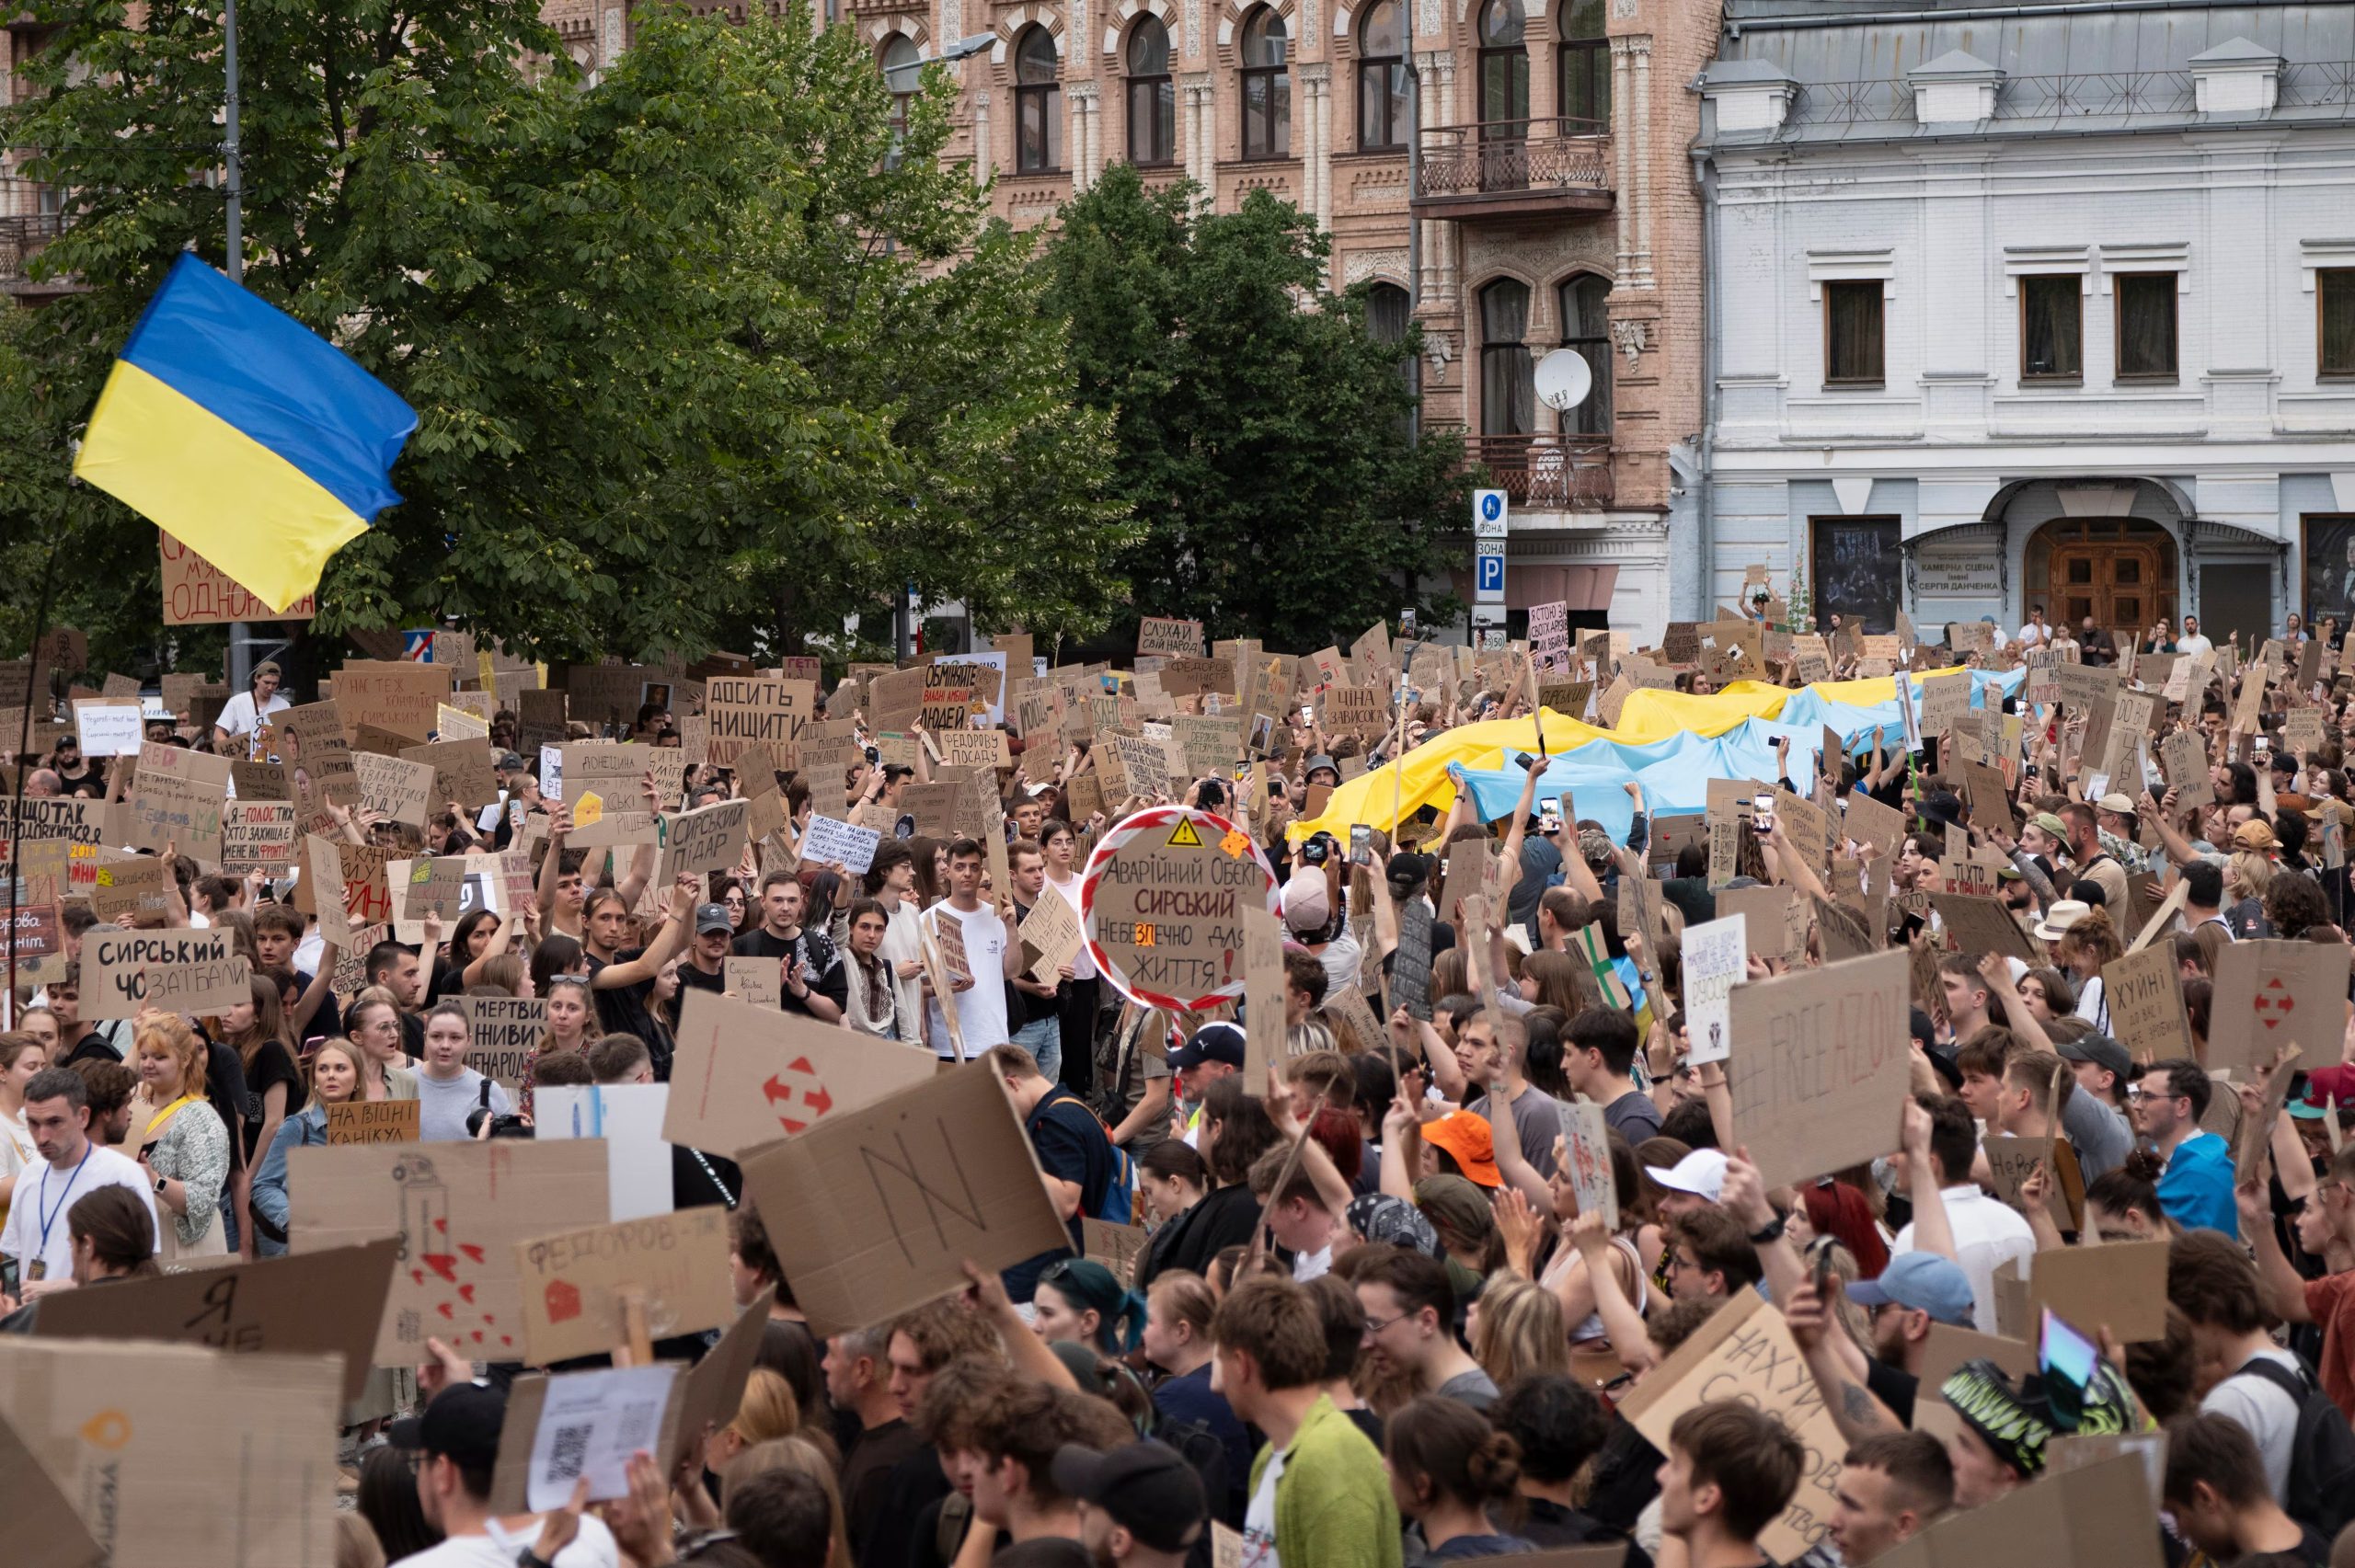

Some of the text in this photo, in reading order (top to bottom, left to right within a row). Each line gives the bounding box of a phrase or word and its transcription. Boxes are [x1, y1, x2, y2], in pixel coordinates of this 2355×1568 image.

[1480, 524, 1502, 533] ЗОНА
[1477, 544, 1504, 555] ЗОНА
[1922, 563, 1995, 572] КАМЕРНА СЦЕНА
[1919, 582, 1998, 591] СЕРГІЯ ДАНЧЕНКА
[1143, 620, 1192, 642] СЛУХАЙ
[1142, 639, 1198, 654] СВІЙ НАРОД
[1494, 636, 1503, 647] 50
[787, 658, 819, 669] ГЕТЬ
[1170, 662, 1229, 673] ФЕДОРОВ
[2030, 649, 2065, 671] ДОНАТЬ
[335, 676, 344, 695] У
[374, 677, 405, 693] ТЕЖ
[925, 664, 977, 689] ОБМІНЯЙТЕ
[385, 691, 439, 709] КОНФЛІКТ
[465, 694, 488, 705] DATE
[710, 681, 793, 707] ДОСИТЬ
[1338, 690, 1375, 709] ЦІНА
[361, 709, 420, 725] СИРСЬКИМ
[710, 709, 807, 741] НИЩИТИ
[920, 705, 965, 730] ЛЮДЕЙ
[1329, 709, 1384, 725] ЗАВИСОКА
[308, 741, 323, 751] THE
[944, 733, 998, 750] ФЕДОРОВУ
[2165, 734, 2191, 756] НЕМА
[951, 749, 998, 765] ПОСАДУ
[375, 756, 419, 778] ПОВИНЕН
[368, 769, 408, 787] ВЛАДИ
[374, 784, 427, 804] БОЯТИСЯ
[51, 801, 86, 825] ТАК
[231, 807, 238, 824] Я
[245, 807, 276, 822] ГОЛОС
[672, 806, 743, 848] СИРСЬКИЙ
[816, 817, 844, 830] ЛЮДИ
[227, 826, 247, 841] ХТО
[224, 843, 247, 859] МЕНЕ
[248, 844, 259, 859] НА
[671, 831, 729, 875] ПІДАР
[1101, 853, 1203, 886] АВАРІЙНИЙ
[1134, 887, 1235, 919] СИРСЬКИЙ
[1097, 916, 1193, 947] НЕБЕЗПЕЧНО
[98, 933, 226, 967] СИРСЬКИЙ
[148, 962, 246, 1001] ЗАЇБАЛИ
[2114, 968, 2165, 1011] ХУЙНІ
[328, 1105, 354, 1127] НА
[527, 1219, 677, 1275] ФЕДОРОВ
[183, 1274, 238, 1328] Я
